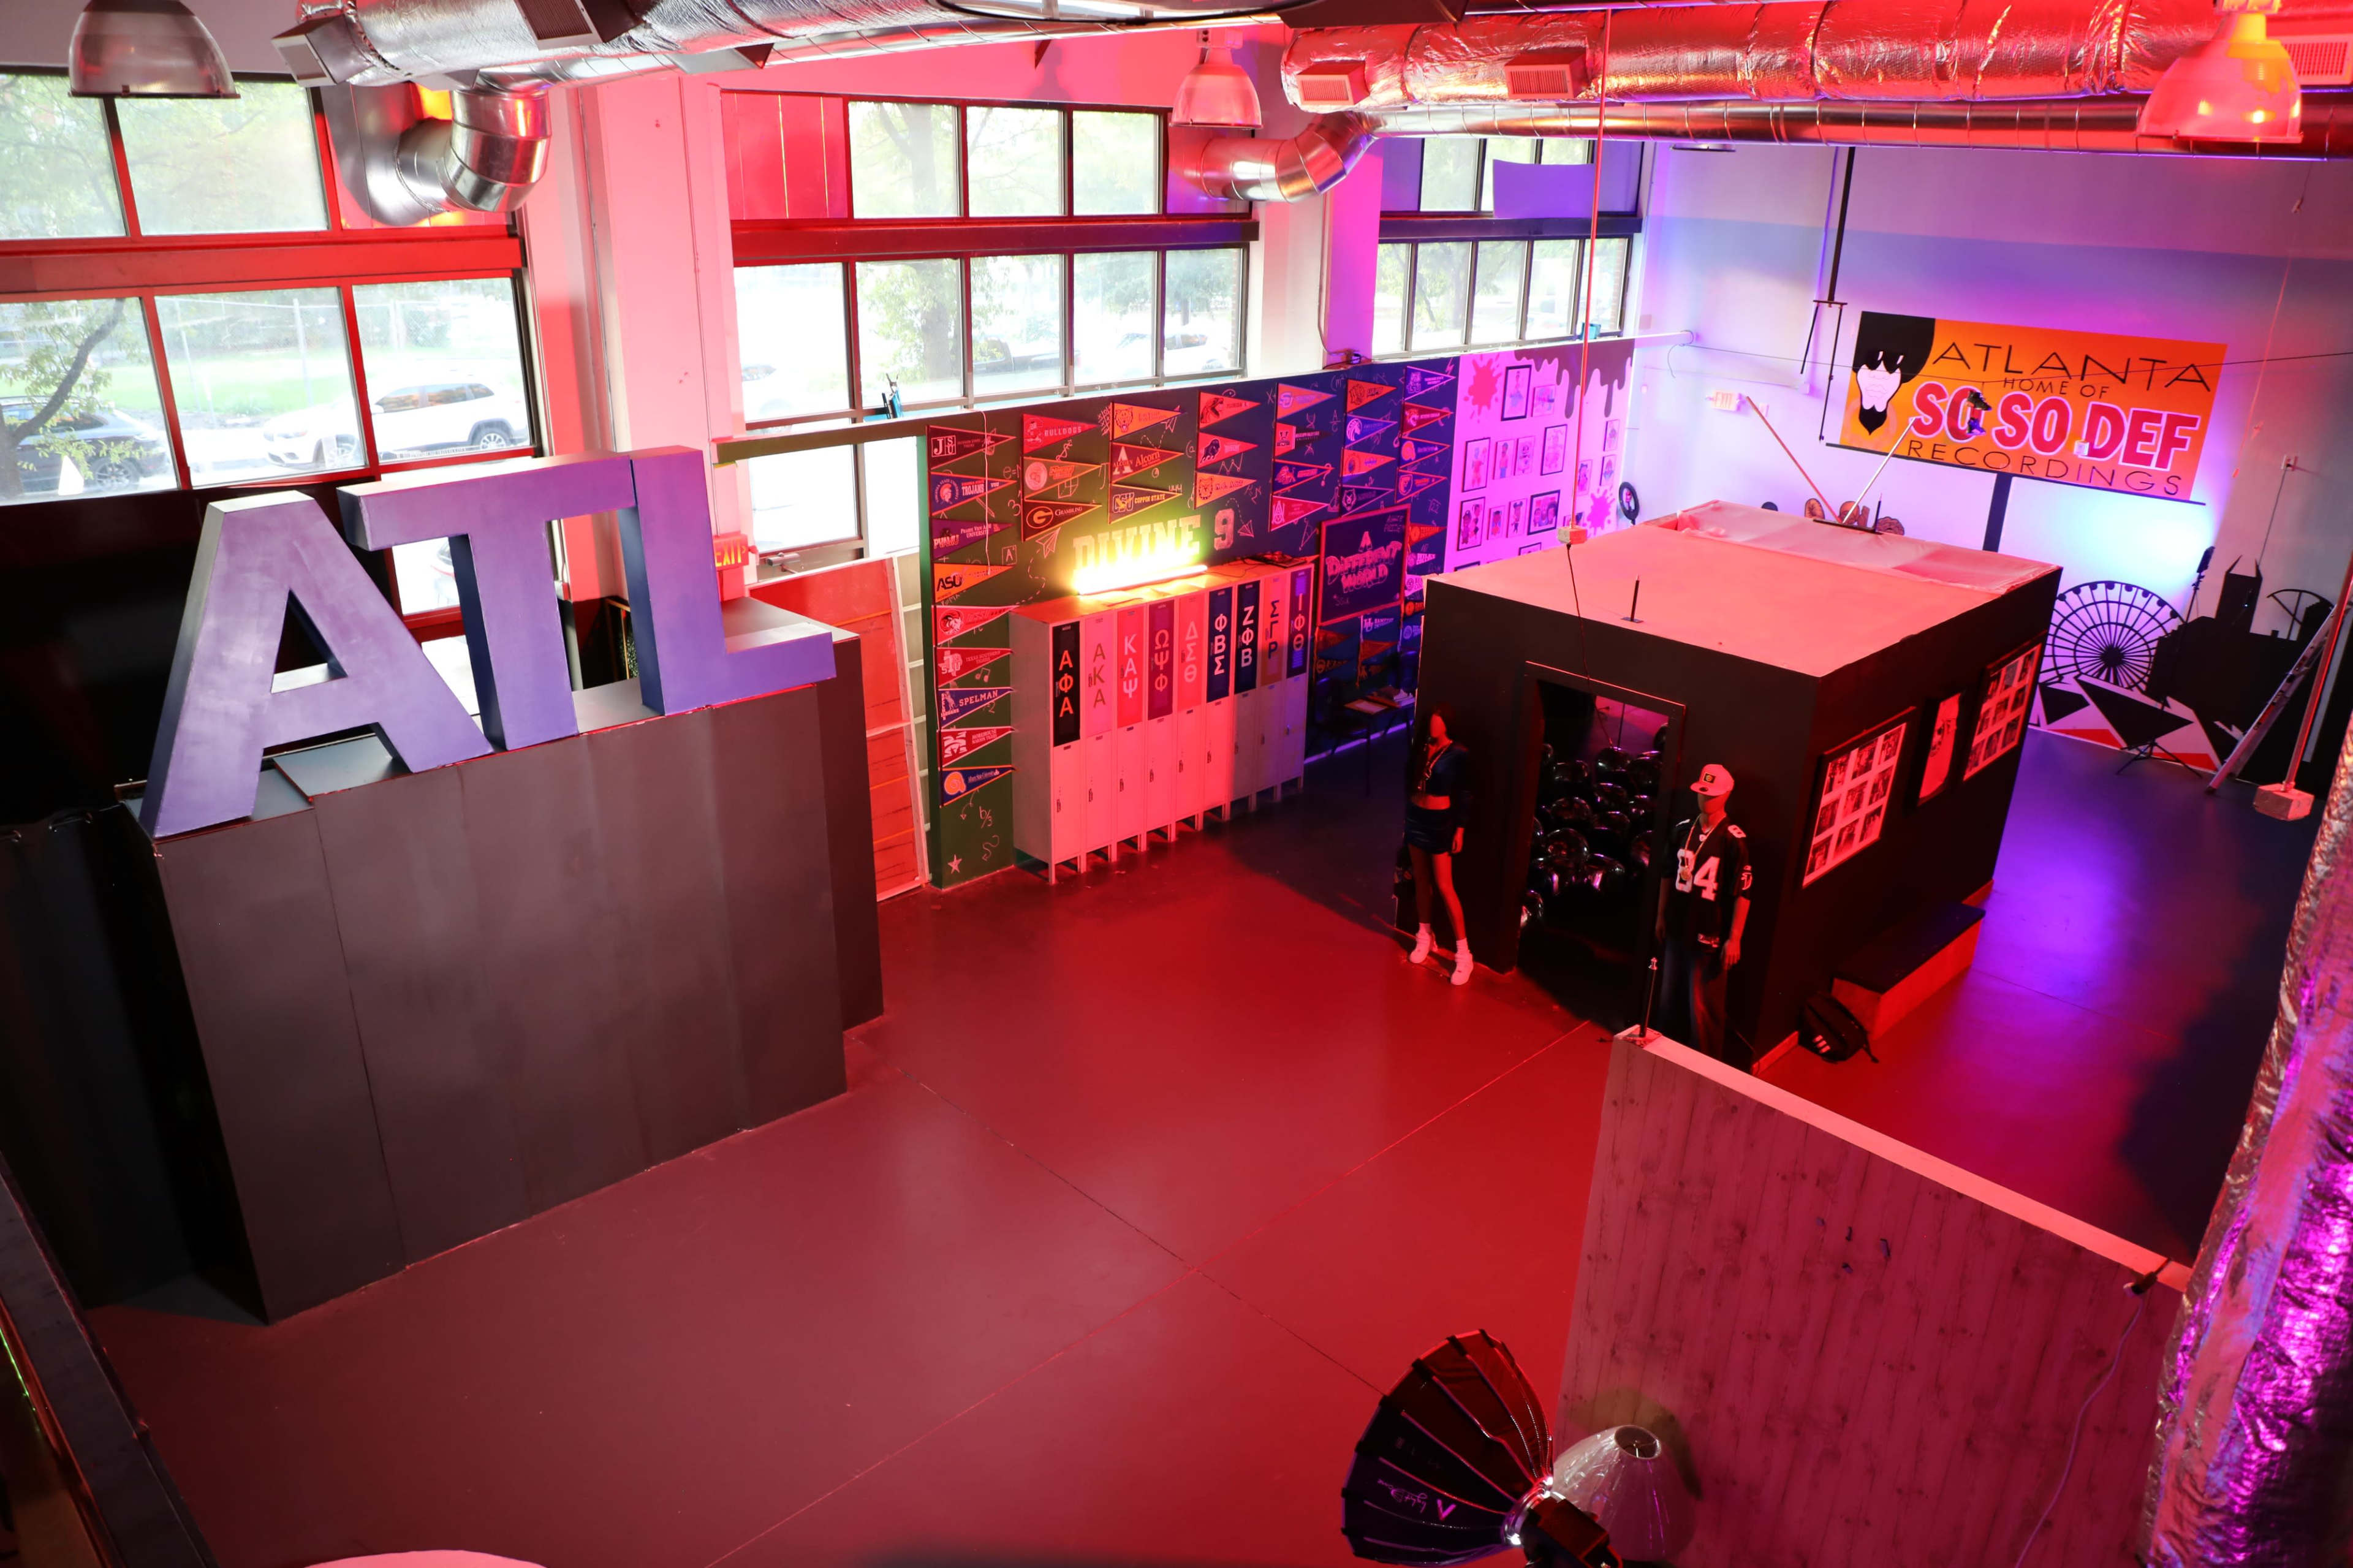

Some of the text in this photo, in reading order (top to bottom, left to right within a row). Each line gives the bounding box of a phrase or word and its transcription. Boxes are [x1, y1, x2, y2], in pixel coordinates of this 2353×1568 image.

[1933, 341, 2211, 392] ATLANTA
[2002, 377, 2110, 400] HOME OF
[1044, 426, 1082, 437] BULLDOGS
[1909, 381, 2203, 471] SO SO DEF
[1135, 451, 1161, 467] Alcorn
[1906, 440, 2182, 496] RECORDINGS
[961, 483, 984, 496] TROJANS
[1151, 493, 1165, 502] STATE
[1073, 508, 1235, 573] DIVINE 9
[1358, 531, 1373, 552] A
[937, 575, 963, 592] ASU
[1341, 563, 1389, 594] WORLD
[138, 445, 836, 840] ATL
[959, 690, 998, 706] SPELMAN
[1675, 848, 1720, 901] 84
